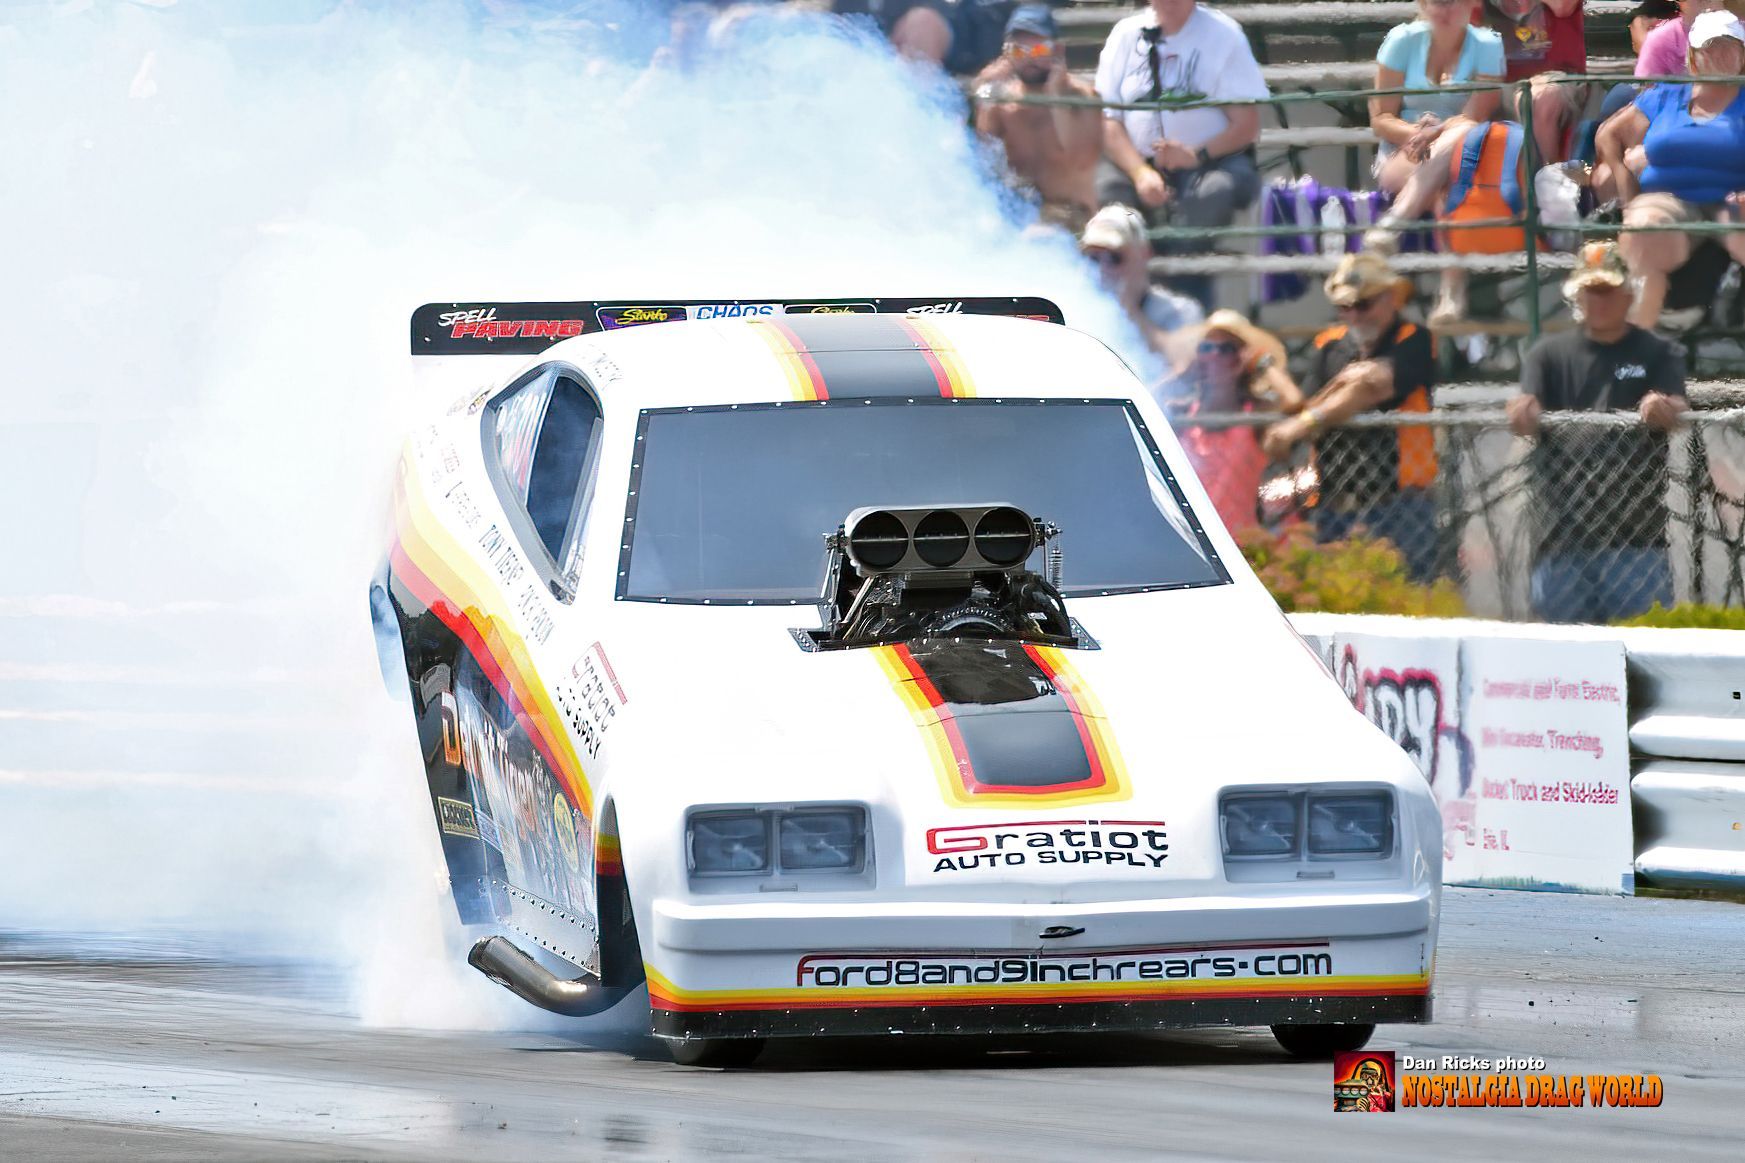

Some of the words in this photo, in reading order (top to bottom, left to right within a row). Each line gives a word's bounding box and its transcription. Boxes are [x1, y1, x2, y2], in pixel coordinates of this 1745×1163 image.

[438, 308, 497, 326] SPELL
[697, 305, 773, 320] CHAOS
[451, 320, 583, 338] PAVING
[1510, 778, 1538, 801] Truck
[1541, 782, 1560, 802] and
[926, 820, 1168, 855] Gratiot
[933, 852, 1025, 872] AUTO
[1038, 850, 1168, 868] SUPPLY
